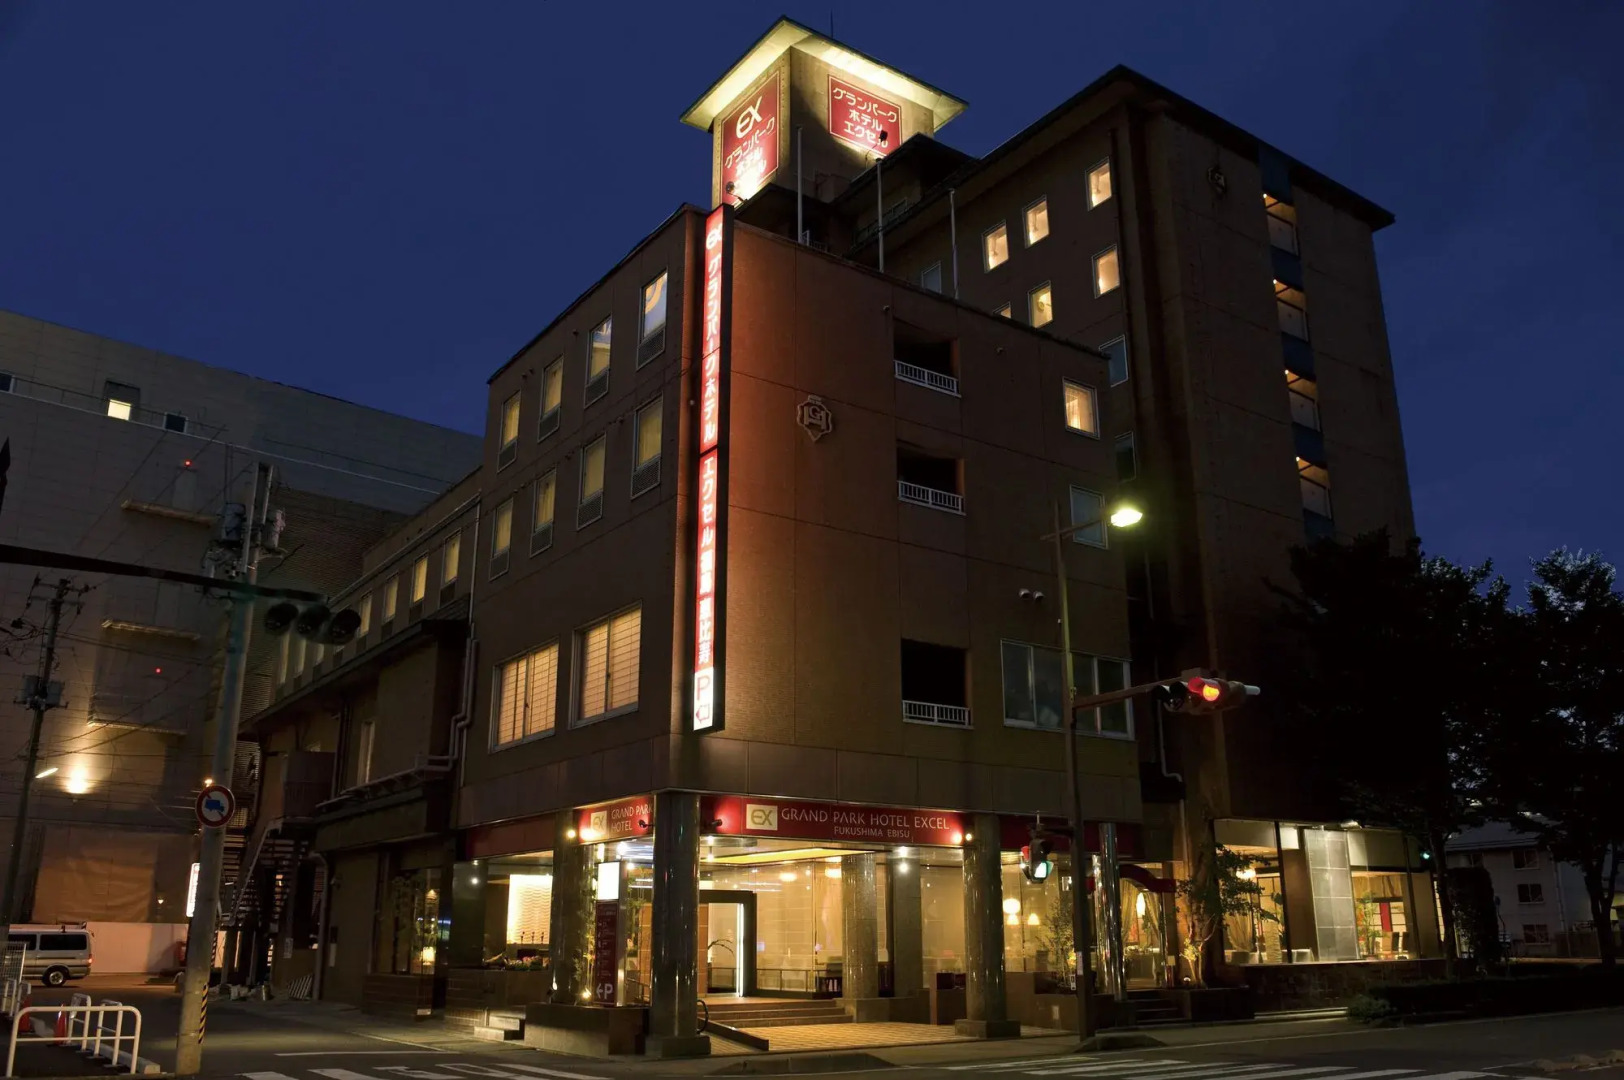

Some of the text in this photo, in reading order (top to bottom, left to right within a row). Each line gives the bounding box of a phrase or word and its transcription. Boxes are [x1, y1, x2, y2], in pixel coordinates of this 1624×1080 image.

[833, 87, 897, 123] グランパーク
[849, 109, 882, 131] ホテル
[724, 117, 775, 169] グランパーク
[697, 675, 710, 701] P
[611, 803, 654, 820] GRAND PARK
[751, 808, 950, 830] EX GRAND PARK HOTEL EXCEL
[611, 820, 634, 833] HOTEL
[834, 826, 911, 839] FUKUSHIMA EBISU
[604, 983, 614, 1000] P
